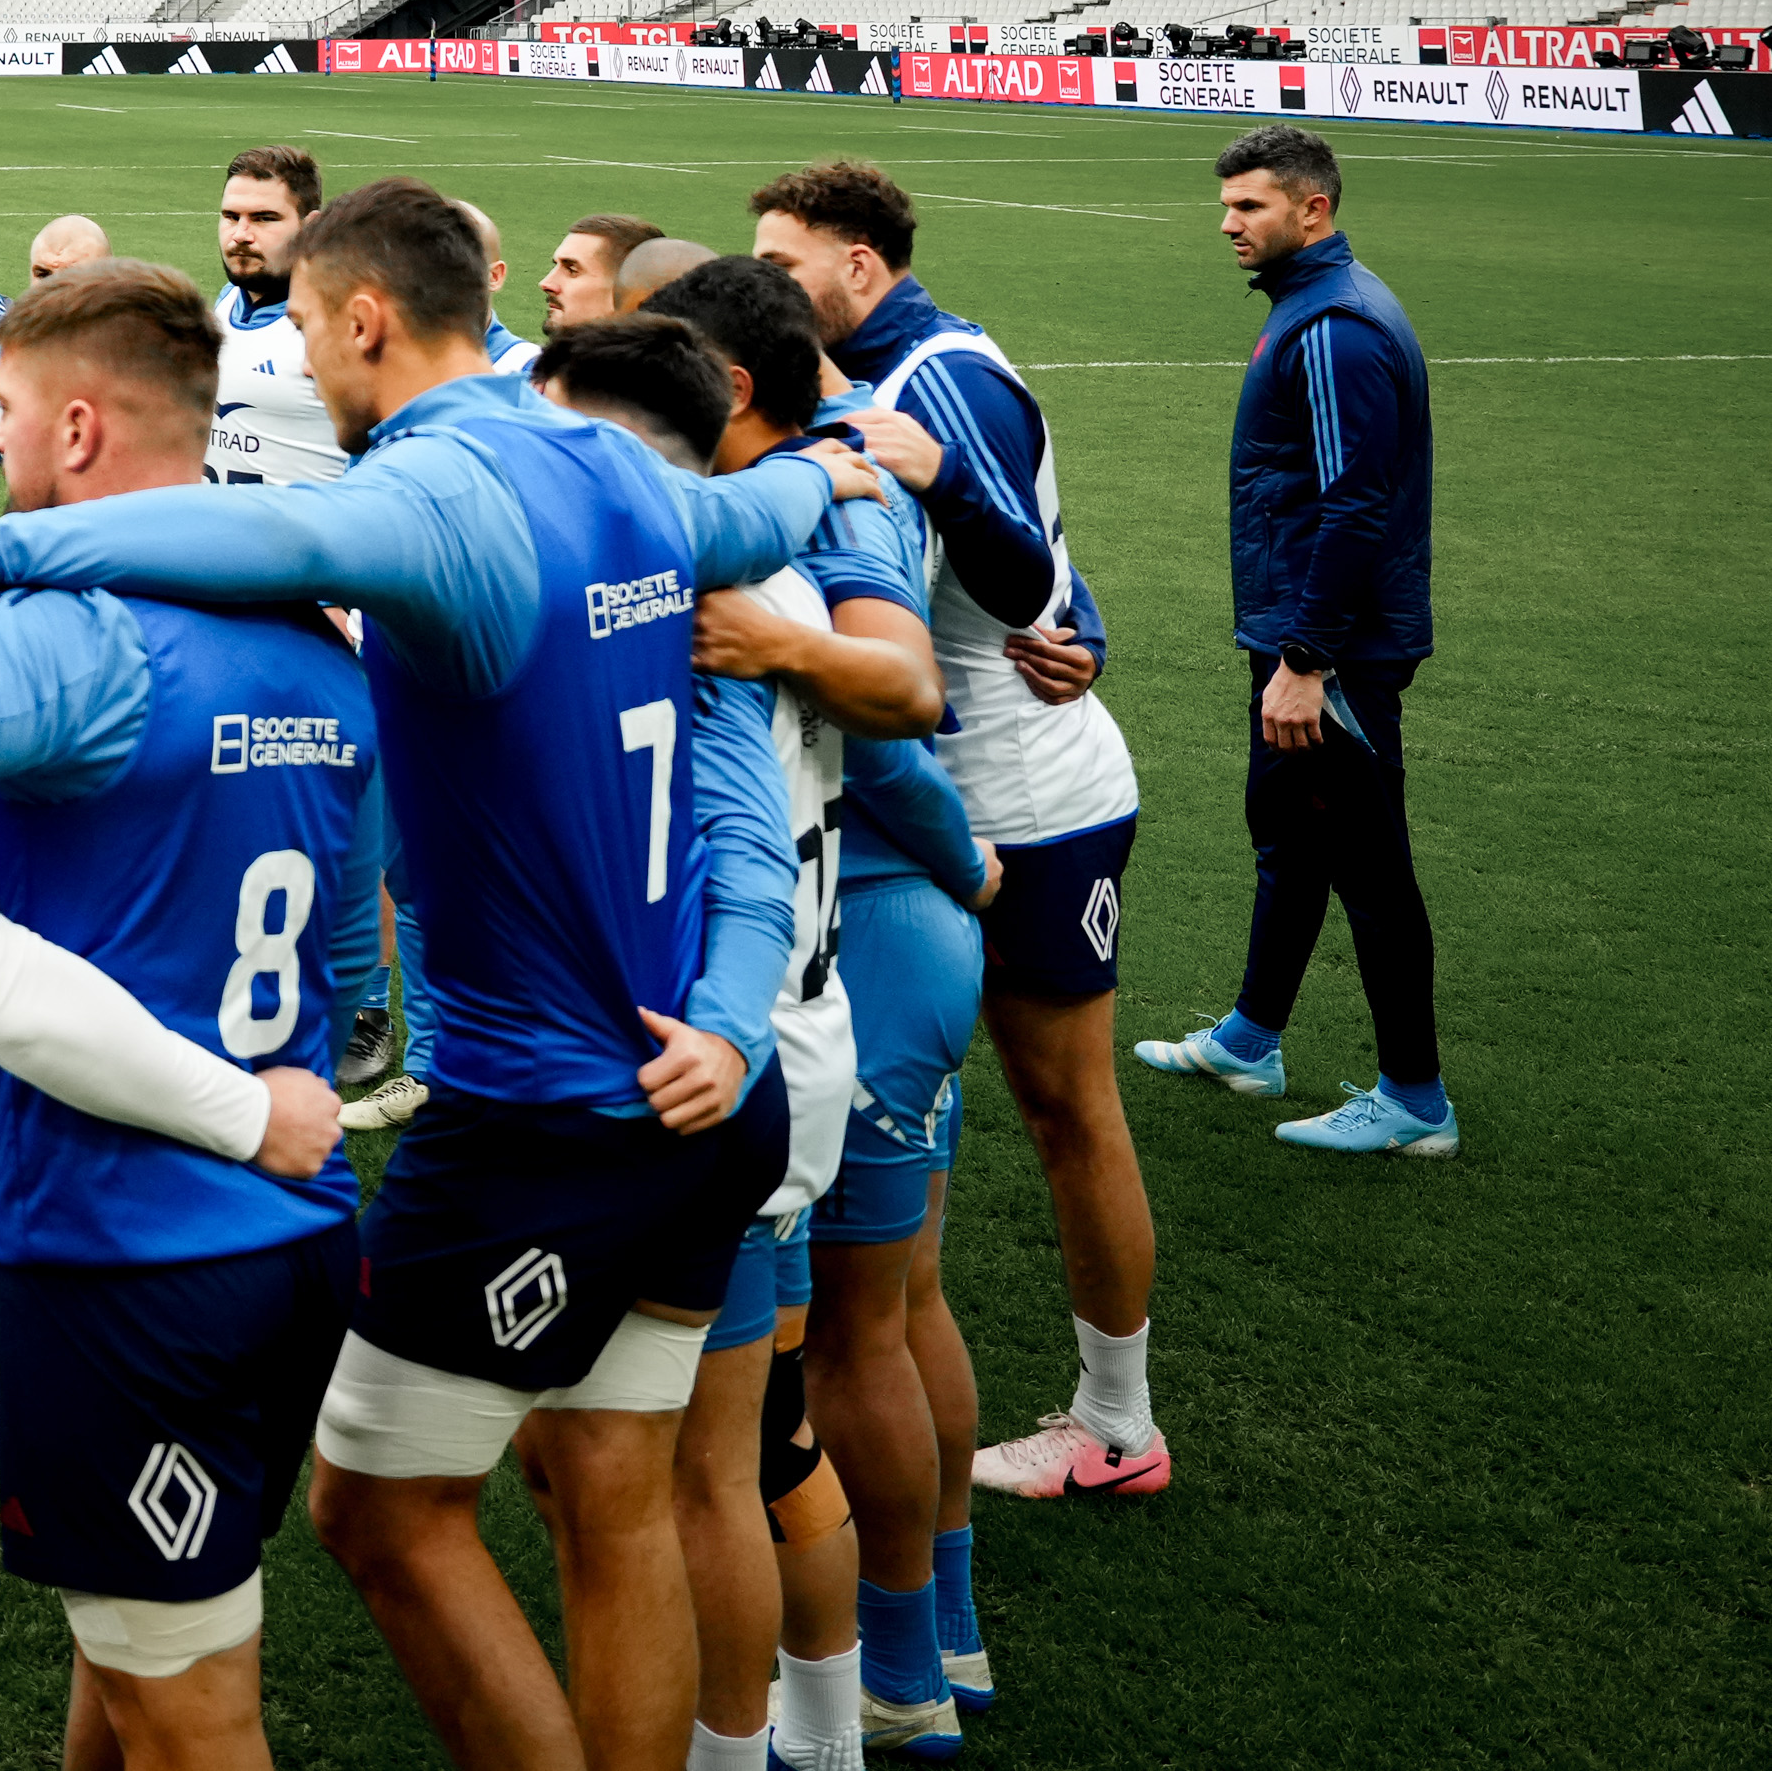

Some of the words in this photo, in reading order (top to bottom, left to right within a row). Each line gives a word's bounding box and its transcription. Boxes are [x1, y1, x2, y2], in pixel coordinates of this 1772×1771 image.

[1309, 28, 1382, 44] SOCIETE
[378, 43, 475, 68] ALTRAD
[530, 45, 566, 58] SOCIETE
[628, 56, 668, 72] RENAULT
[532, 61, 576, 76] GENERALE
[693, 59, 739, 75] RENAULT
[944, 56, 1043, 96] ALTRAD
[1159, 63, 1235, 82] SOCIETE
[1160, 86, 1255, 108] GENERALE
[1374, 80, 1468, 105] RENAULT
[1523, 85, 1629, 111] RENAULT
[607, 570, 679, 605] SOCIETE
[611, 592, 693, 629] GENERALE
[252, 717, 339, 743] SOCIETE
[250, 742, 357, 767] GENERALE
[620, 698, 676, 903] 7
[218, 849, 315, 1059] 8
